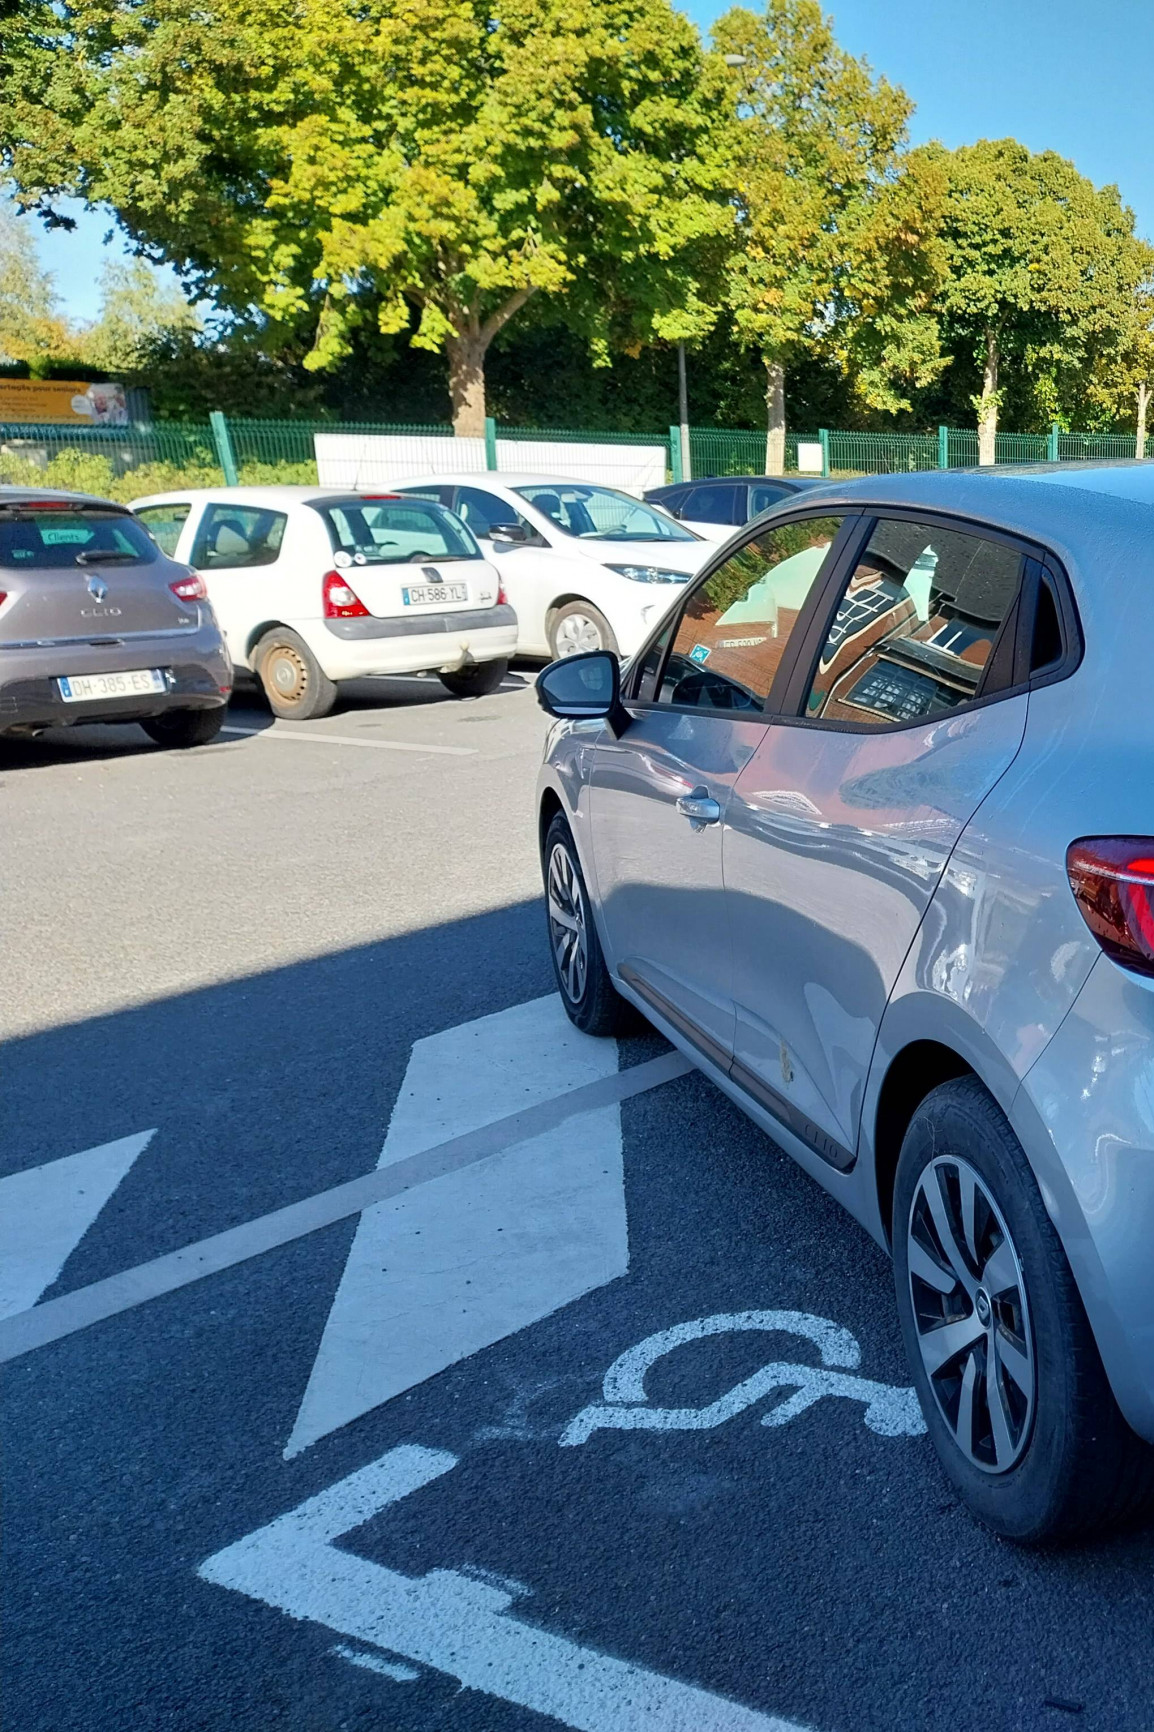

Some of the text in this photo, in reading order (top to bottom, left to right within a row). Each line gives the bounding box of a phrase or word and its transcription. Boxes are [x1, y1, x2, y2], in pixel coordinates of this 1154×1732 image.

[47, 532, 80, 542] Clients
[80, 607, 122, 618] CLIO
[72, 673, 150, 697] DH-385-ES
